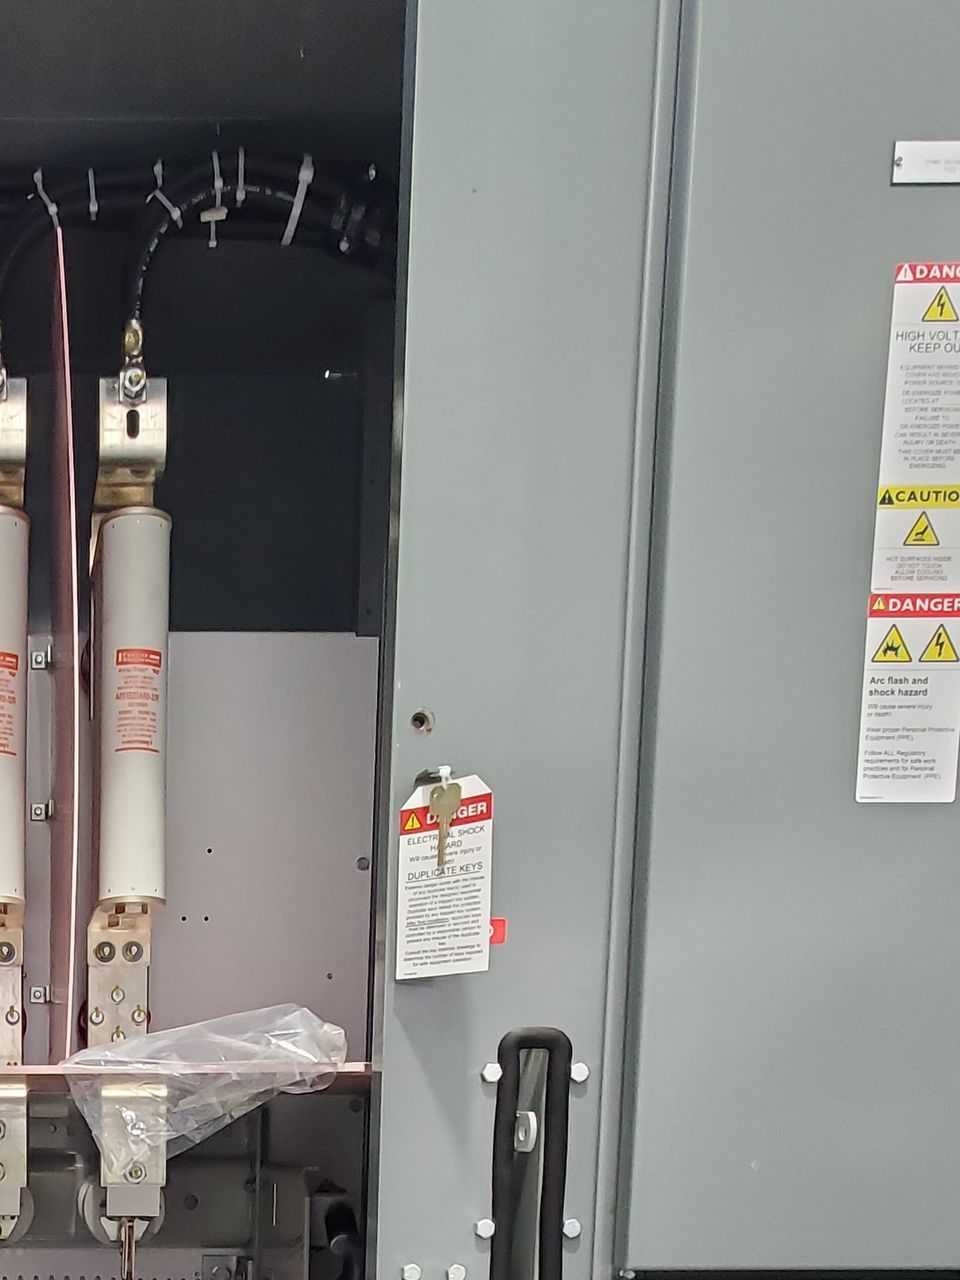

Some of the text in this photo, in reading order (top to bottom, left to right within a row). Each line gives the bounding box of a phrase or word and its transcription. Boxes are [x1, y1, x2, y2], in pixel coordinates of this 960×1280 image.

[896, 331, 960, 341] HIGH VOLT
[909, 343, 941, 353] KEEP
[869, 676, 928, 685] Arc flash and
[898, 688, 928, 696] hazard
[427, 802, 487, 824] DGER
[408, 825, 485, 846] ELECTRAL SHOCK
[430, 840, 462, 851] HARD
[408, 862, 482, 880] DUPLICATE KEYS
